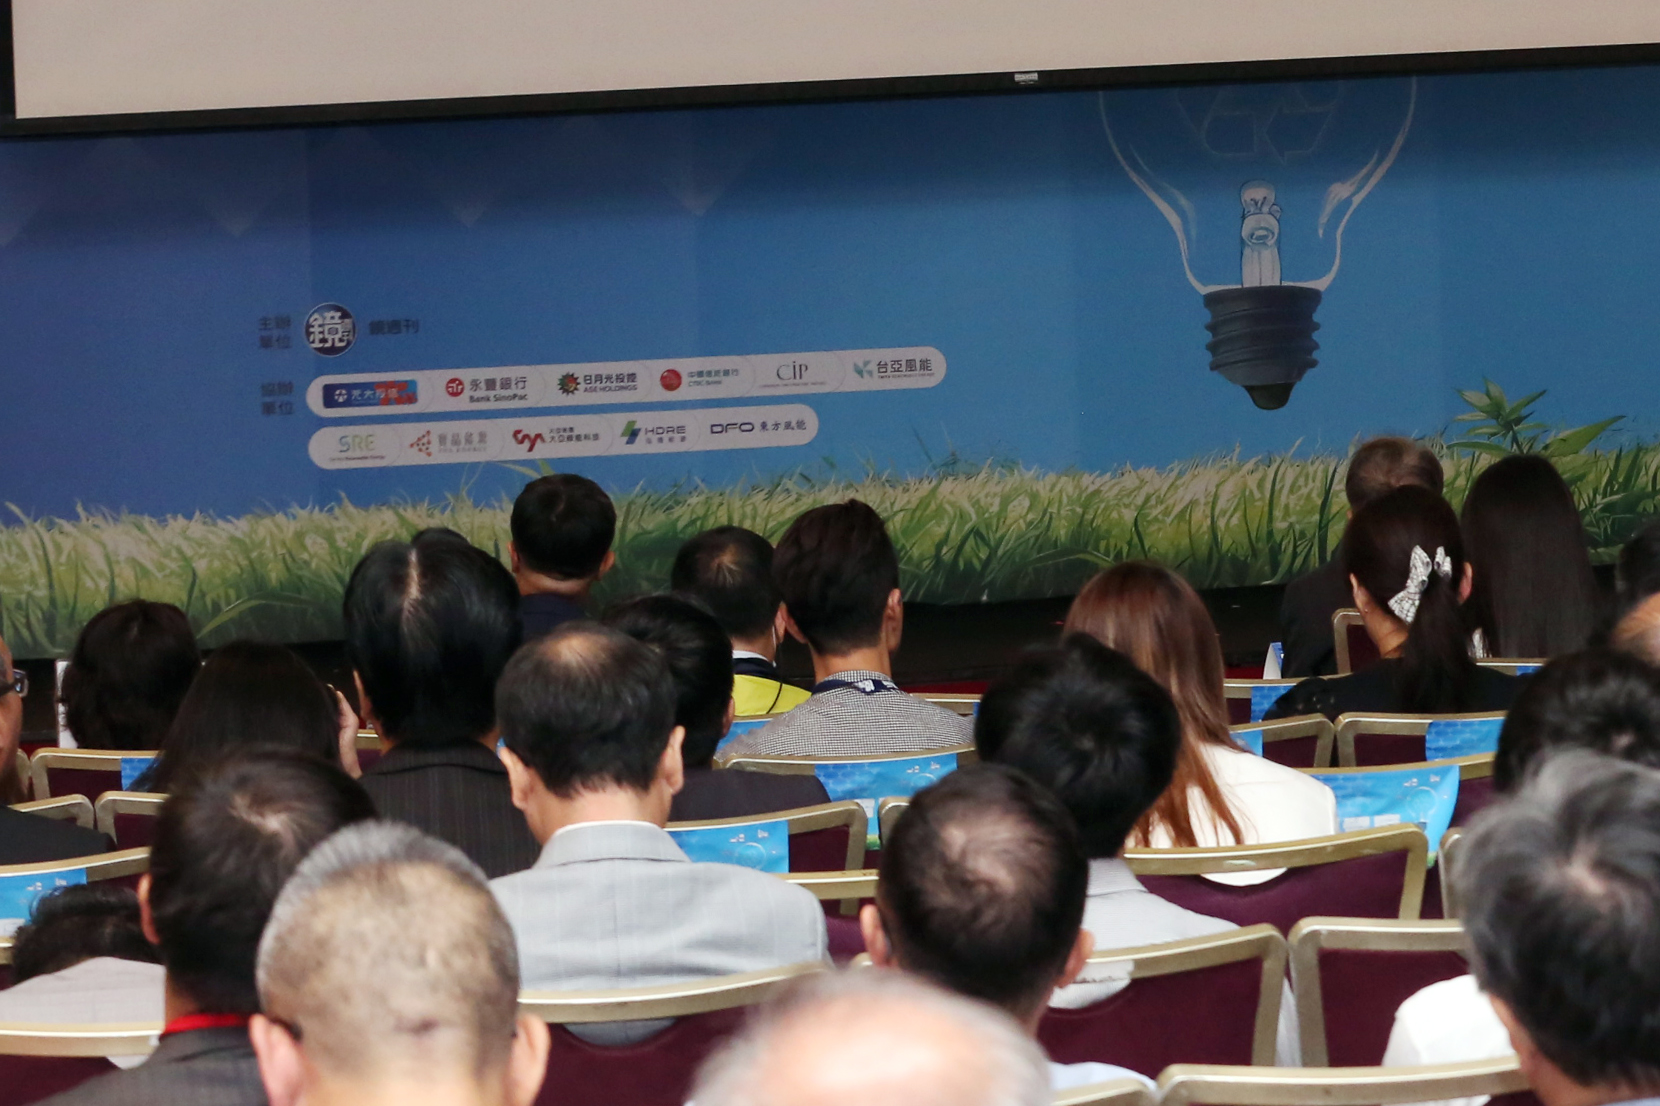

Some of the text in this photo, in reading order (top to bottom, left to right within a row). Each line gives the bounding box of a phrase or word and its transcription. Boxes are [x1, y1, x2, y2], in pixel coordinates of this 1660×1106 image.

[876, 358, 933, 374] 台亞風能
[644, 425, 686, 435] HDRE
[710, 422, 755, 435] DFO
[338, 433, 376, 453] SRE
